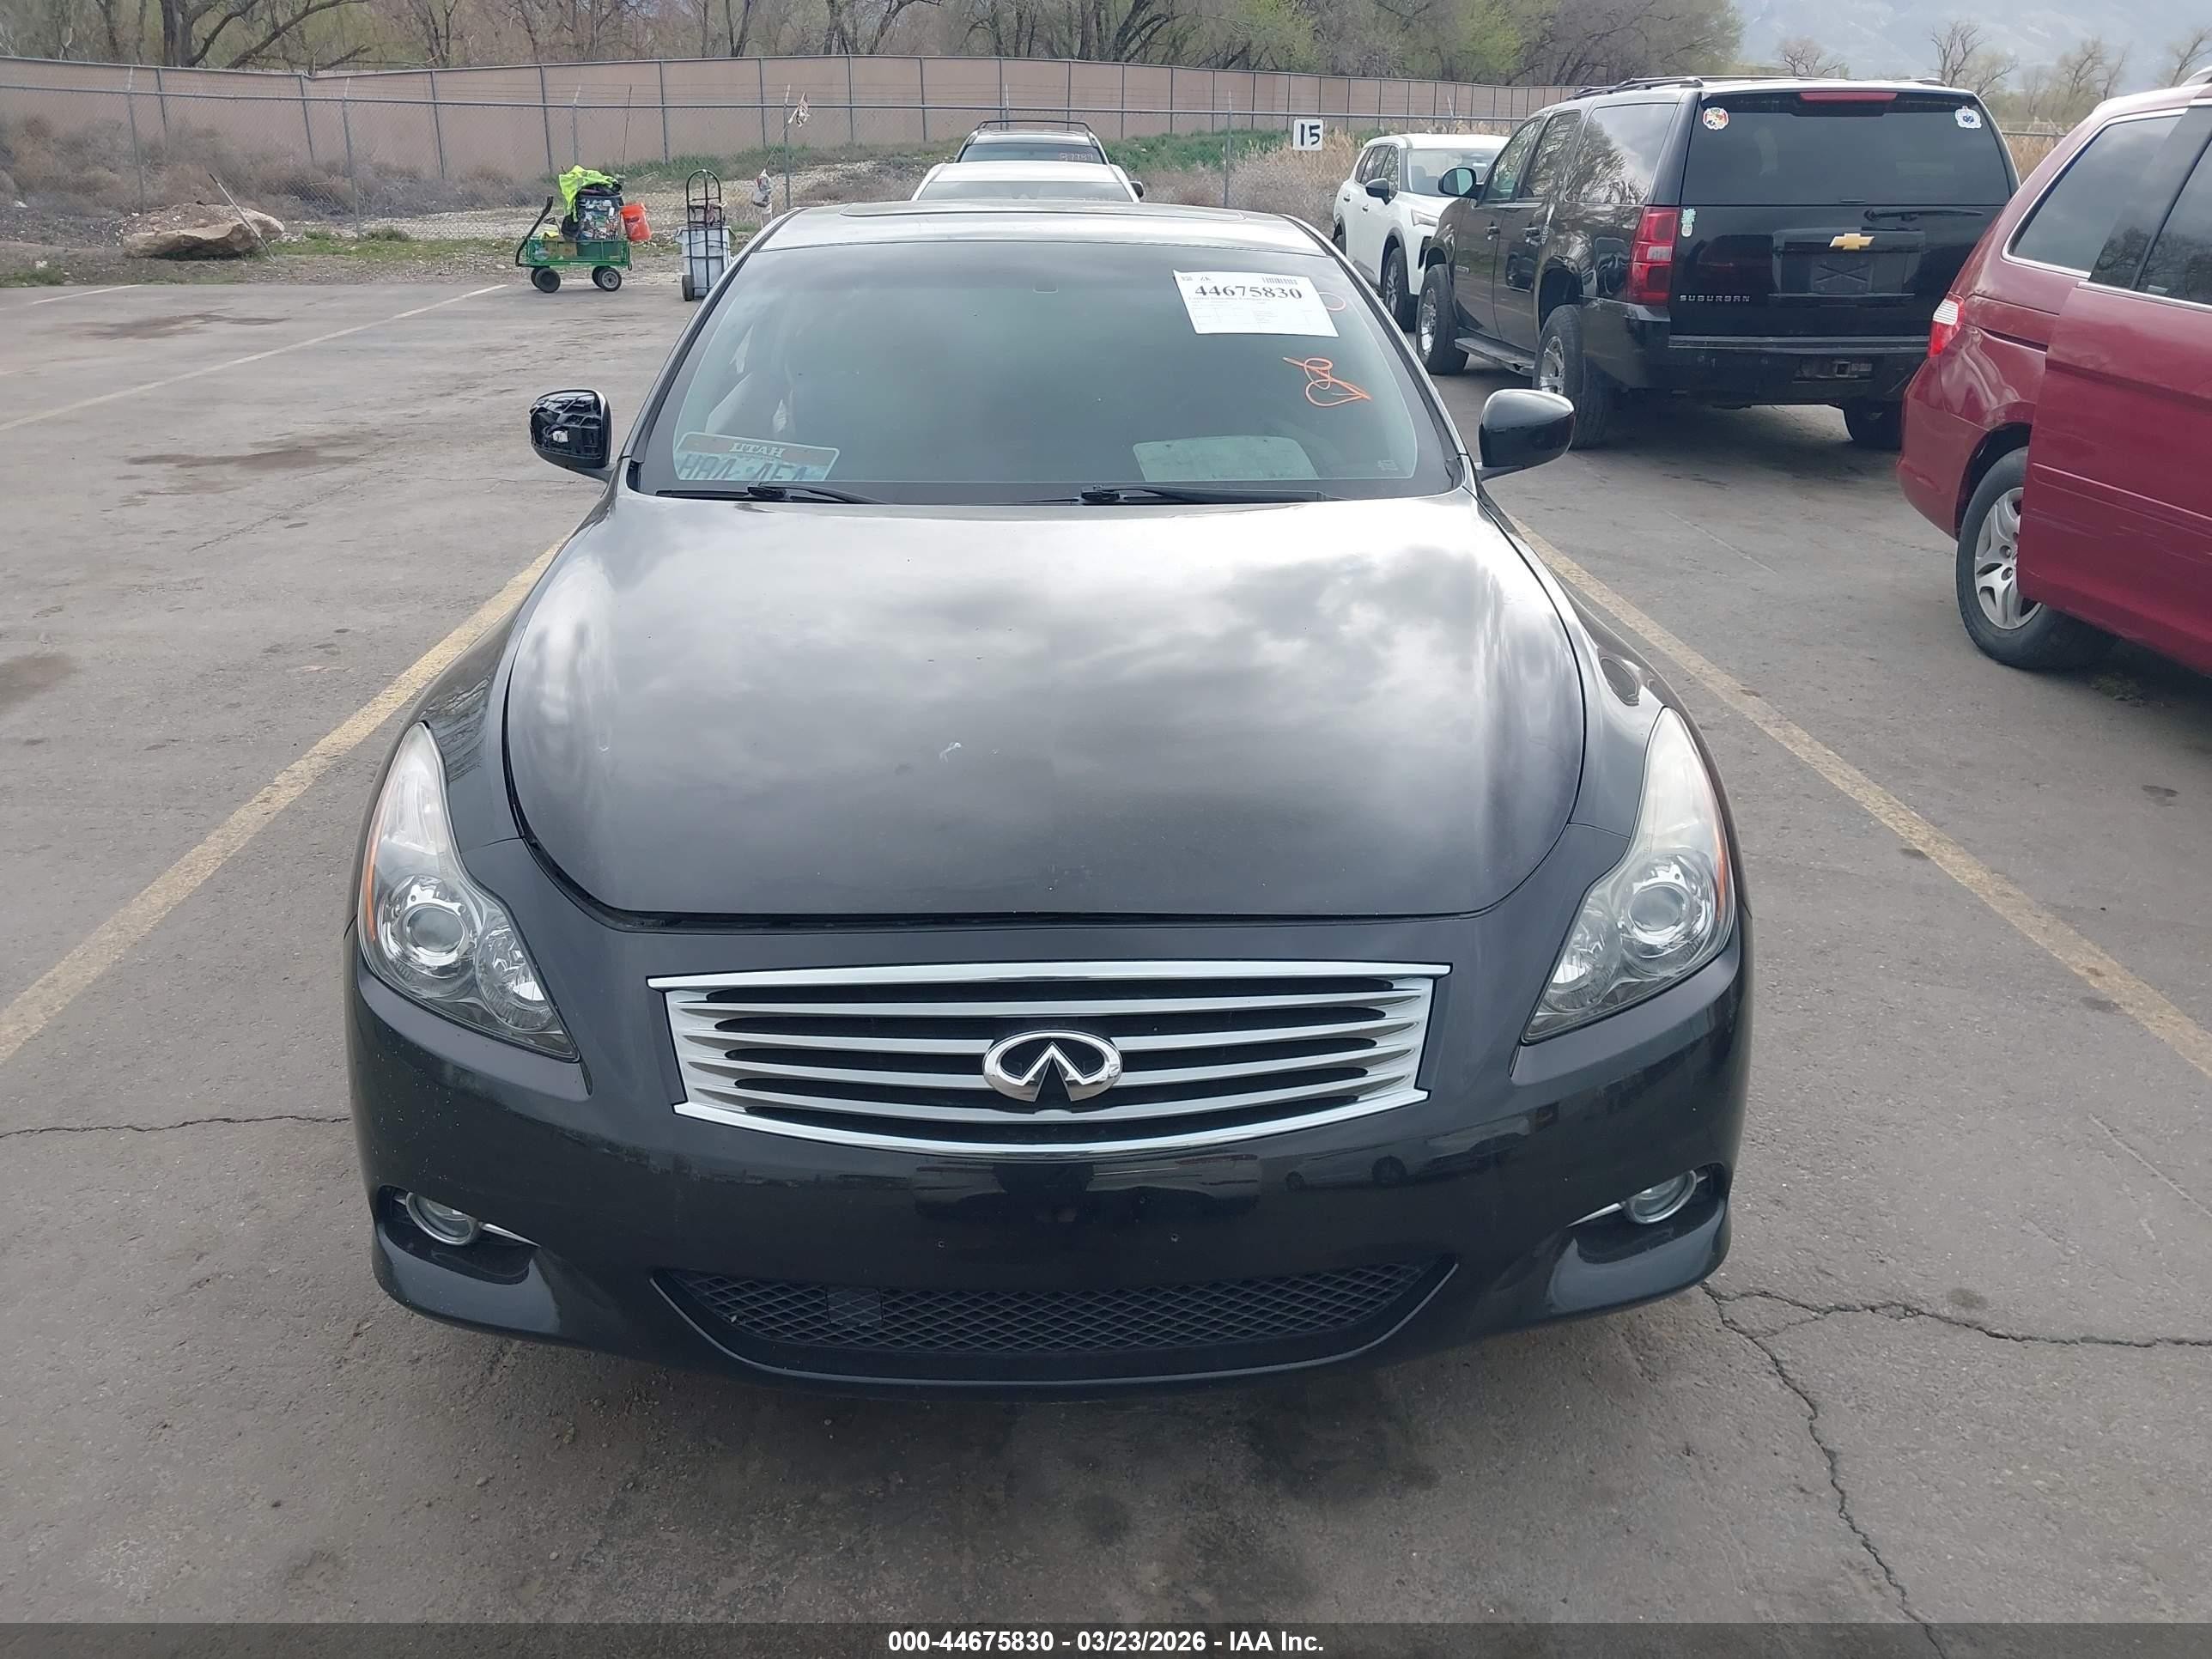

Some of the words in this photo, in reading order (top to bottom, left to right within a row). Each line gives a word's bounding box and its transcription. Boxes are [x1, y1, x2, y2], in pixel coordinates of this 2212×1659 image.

[1300, 123, 1321, 146] 15
[1194, 285, 1303, 300] 44675830
[729, 442, 786, 458] UTAH
